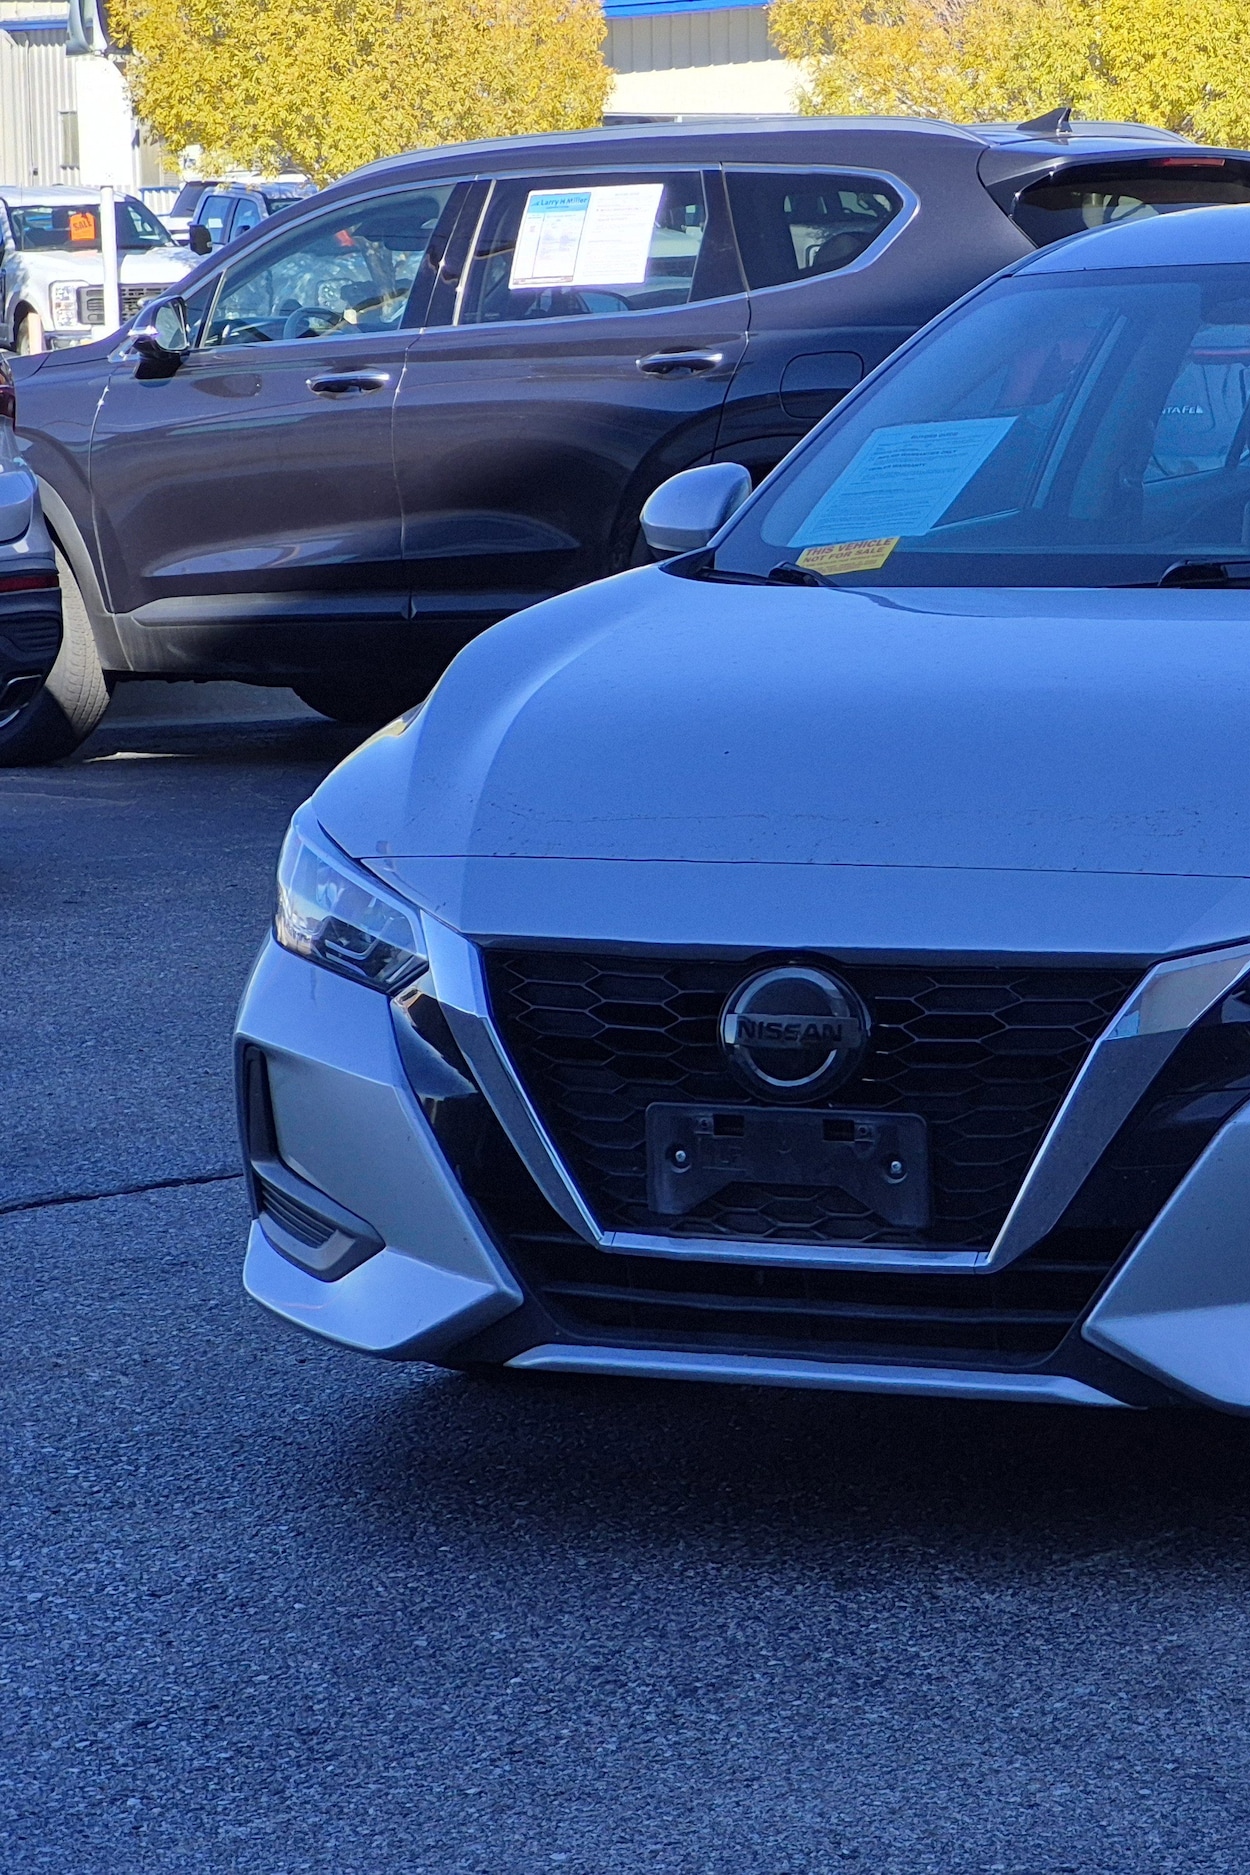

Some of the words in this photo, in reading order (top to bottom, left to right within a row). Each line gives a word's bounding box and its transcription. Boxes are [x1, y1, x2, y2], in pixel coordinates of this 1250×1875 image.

[803, 555, 826, 563] NOT
[828, 551, 853, 560] FOR
[855, 547, 885, 556] SALE
[806, 547, 835, 556] THIS
[838, 538, 894, 551] VEHICLE
[737, 1018, 841, 1042] NISSAN
